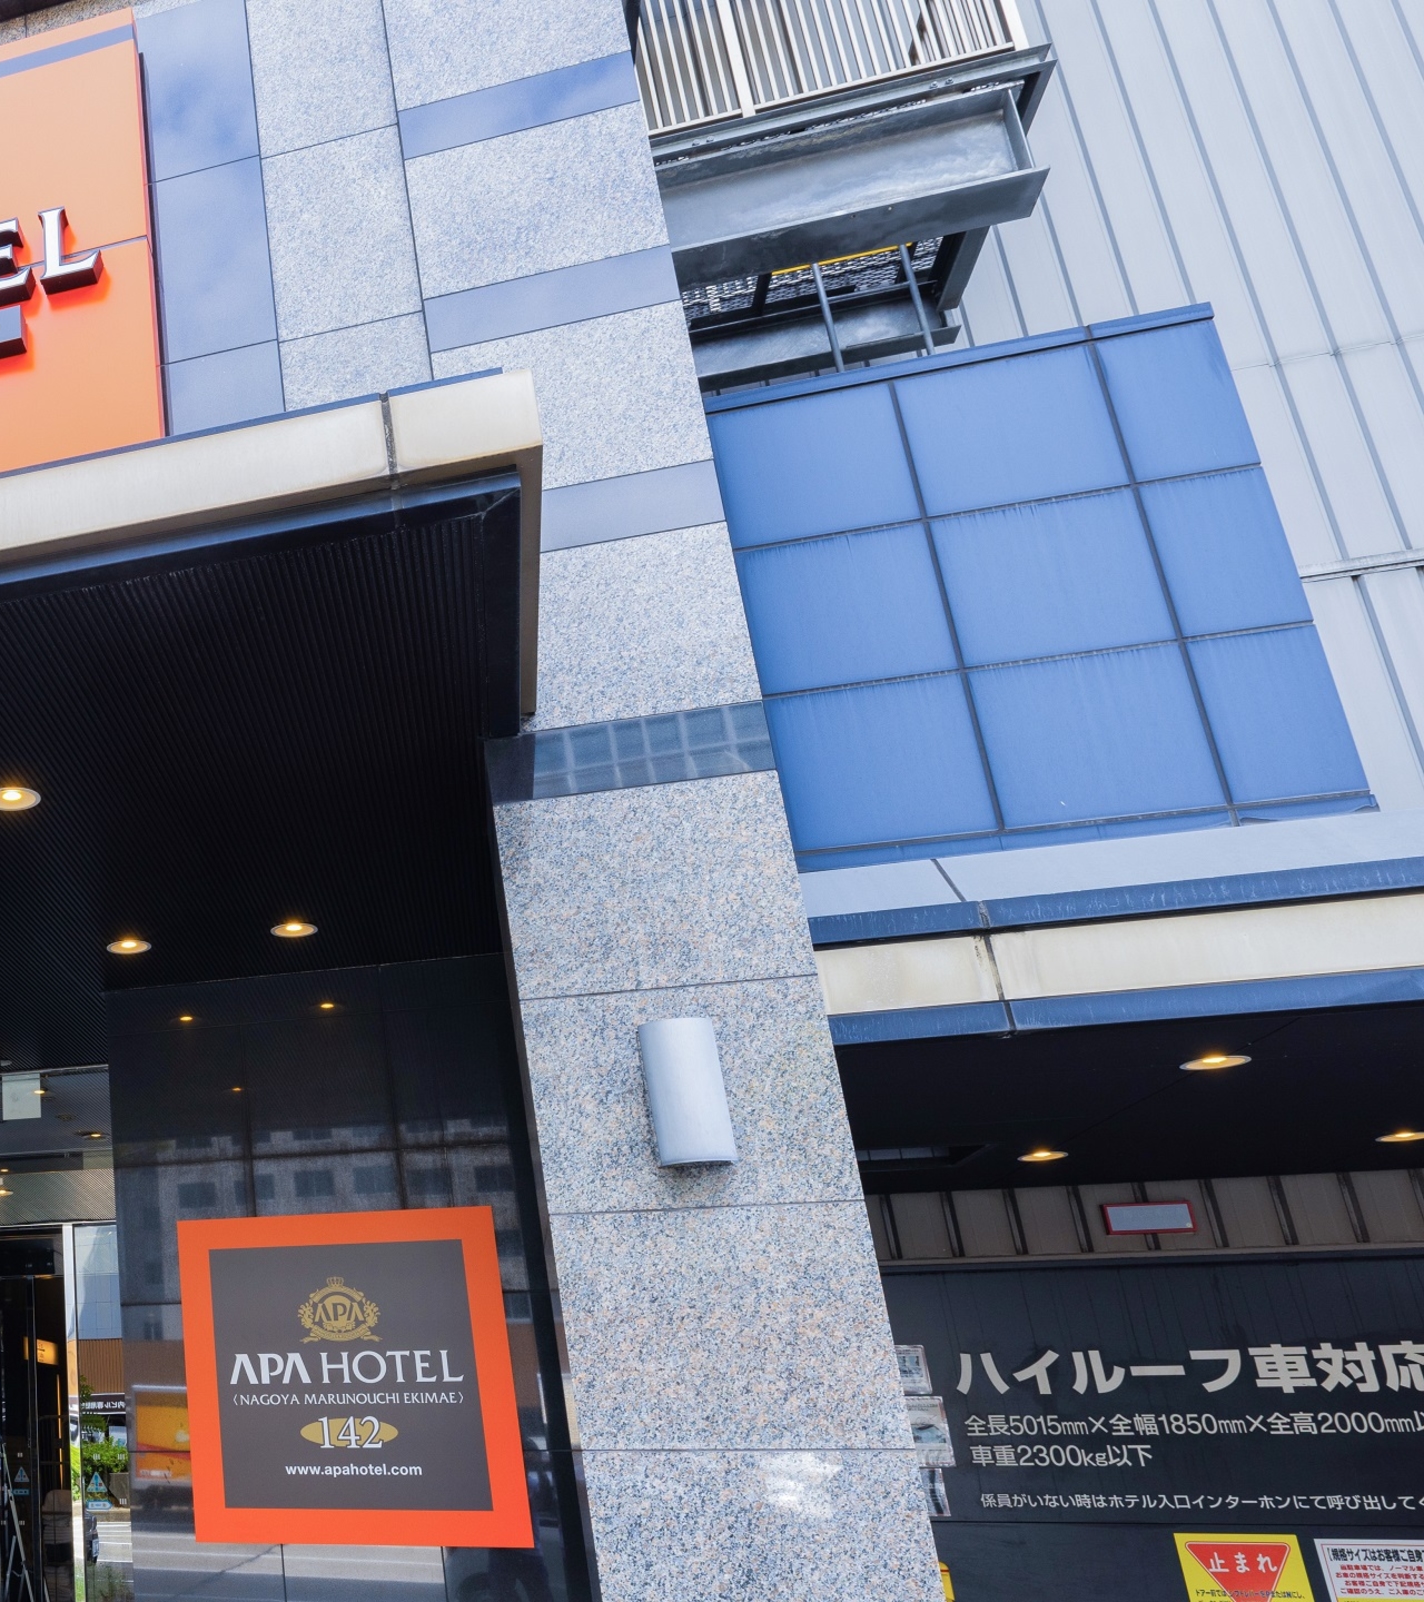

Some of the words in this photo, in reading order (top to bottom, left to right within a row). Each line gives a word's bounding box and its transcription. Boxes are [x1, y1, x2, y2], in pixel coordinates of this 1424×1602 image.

[314, 1302, 365, 1322] APA
[229, 1353, 312, 1385] APA
[320, 1349, 465, 1384] HOTEL
[956, 1340, 1424, 1395] ハイルーフ車対応
[304, 1392, 400, 1405] MARUNOUCHI
[317, 1415, 384, 1450] 142
[970, 1443, 1153, 1469] 車重2300kg以下
[285, 1463, 423, 1477] www.apahotel.com
[1207, 1551, 1278, 1573] 止まれ
